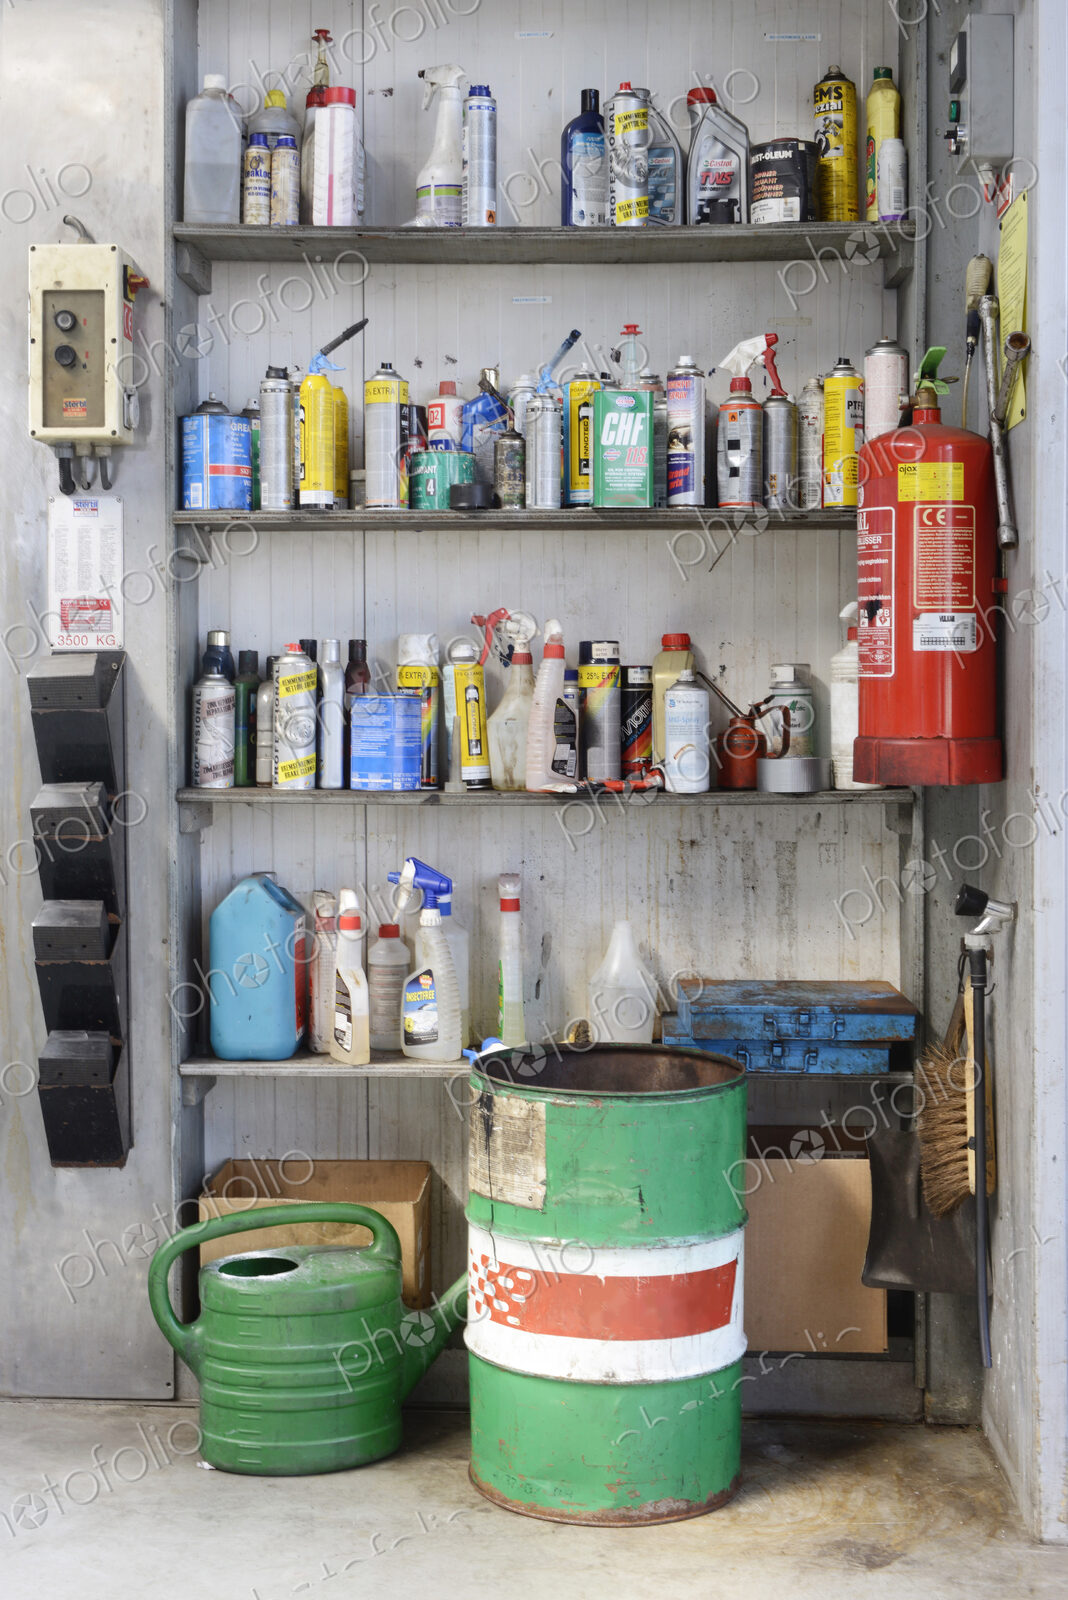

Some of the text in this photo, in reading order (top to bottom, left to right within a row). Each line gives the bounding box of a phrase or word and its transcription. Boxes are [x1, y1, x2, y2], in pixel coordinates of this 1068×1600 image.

[700, 171, 735, 185] TWS
[373, 387, 395, 396] EXTRA
[601, 412, 645, 446] CHF
[625, 447, 648, 463] 11S
[899, 465, 918, 475] ajax
[427, 479, 435, 495] 4
[57, 634, 116, 646] 3500 KG
[405, 671, 427, 680] EXTRA
[586, 672, 600, 680] 25%
[406, 990, 435, 1003] INSECTFREE
